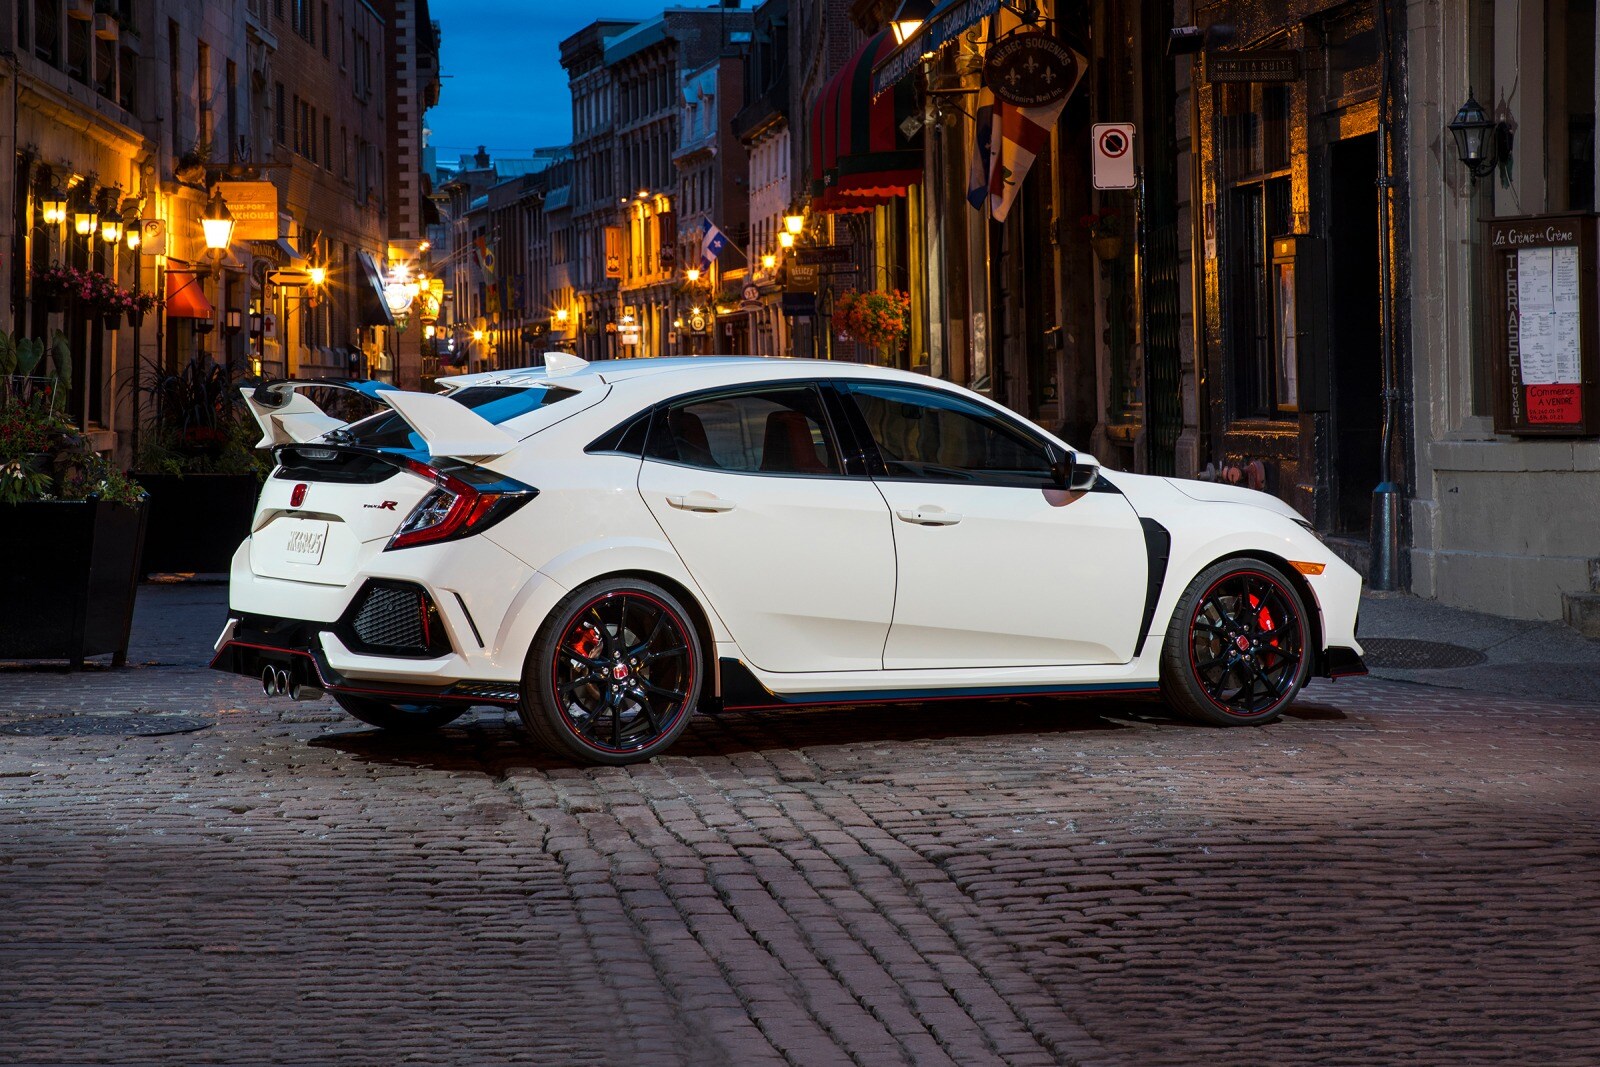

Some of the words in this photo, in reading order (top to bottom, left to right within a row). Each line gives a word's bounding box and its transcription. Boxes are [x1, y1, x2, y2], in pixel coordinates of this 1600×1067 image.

[1025, 38, 1072, 66] SOUVENIRS
[231, 212, 275, 220] AKHOUSE
[1493, 230, 1506, 245] La
[1508, 229, 1535, 245] Crème
[1546, 226, 1574, 243] Crème
[1507, 255, 1519, 368] TERRASSE
[1530, 386, 1575, 398] Commerce
[1546, 397, 1573, 406] VENDRE
[380, 500, 398, 511] R
